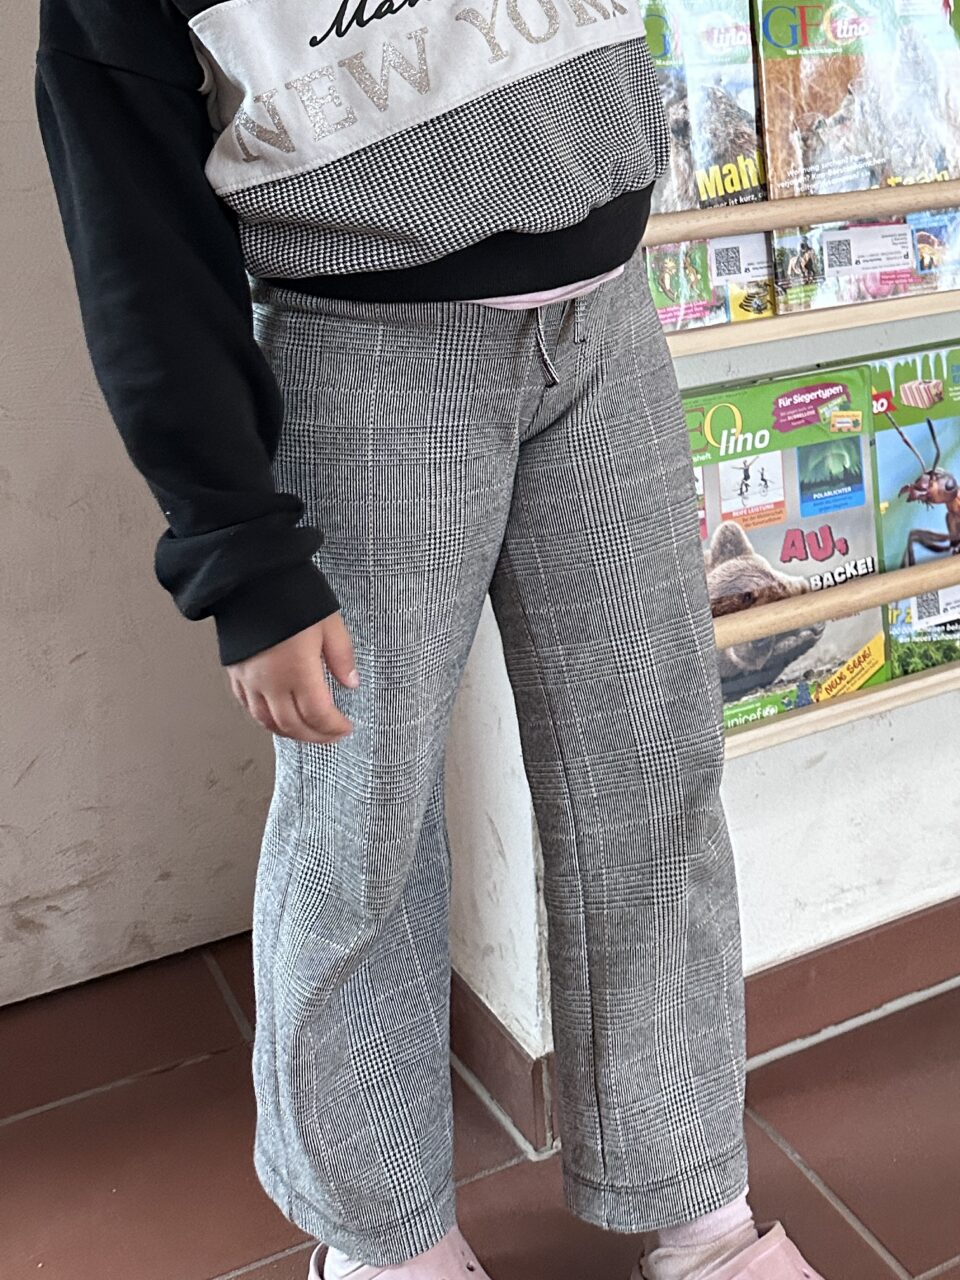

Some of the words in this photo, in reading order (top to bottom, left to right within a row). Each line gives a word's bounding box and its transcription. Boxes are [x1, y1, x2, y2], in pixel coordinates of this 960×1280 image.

[763, 3, 858, 48] GEO
[836, 20, 869, 38] lino
[235, 26, 430, 161] NEW
[778, 396, 792, 408] Für
[792, 385, 843, 405] Siegertypen
[719, 427, 770, 456] lino
[780, 524, 849, 563] AU,
[809, 556, 875, 591] BACKE!
